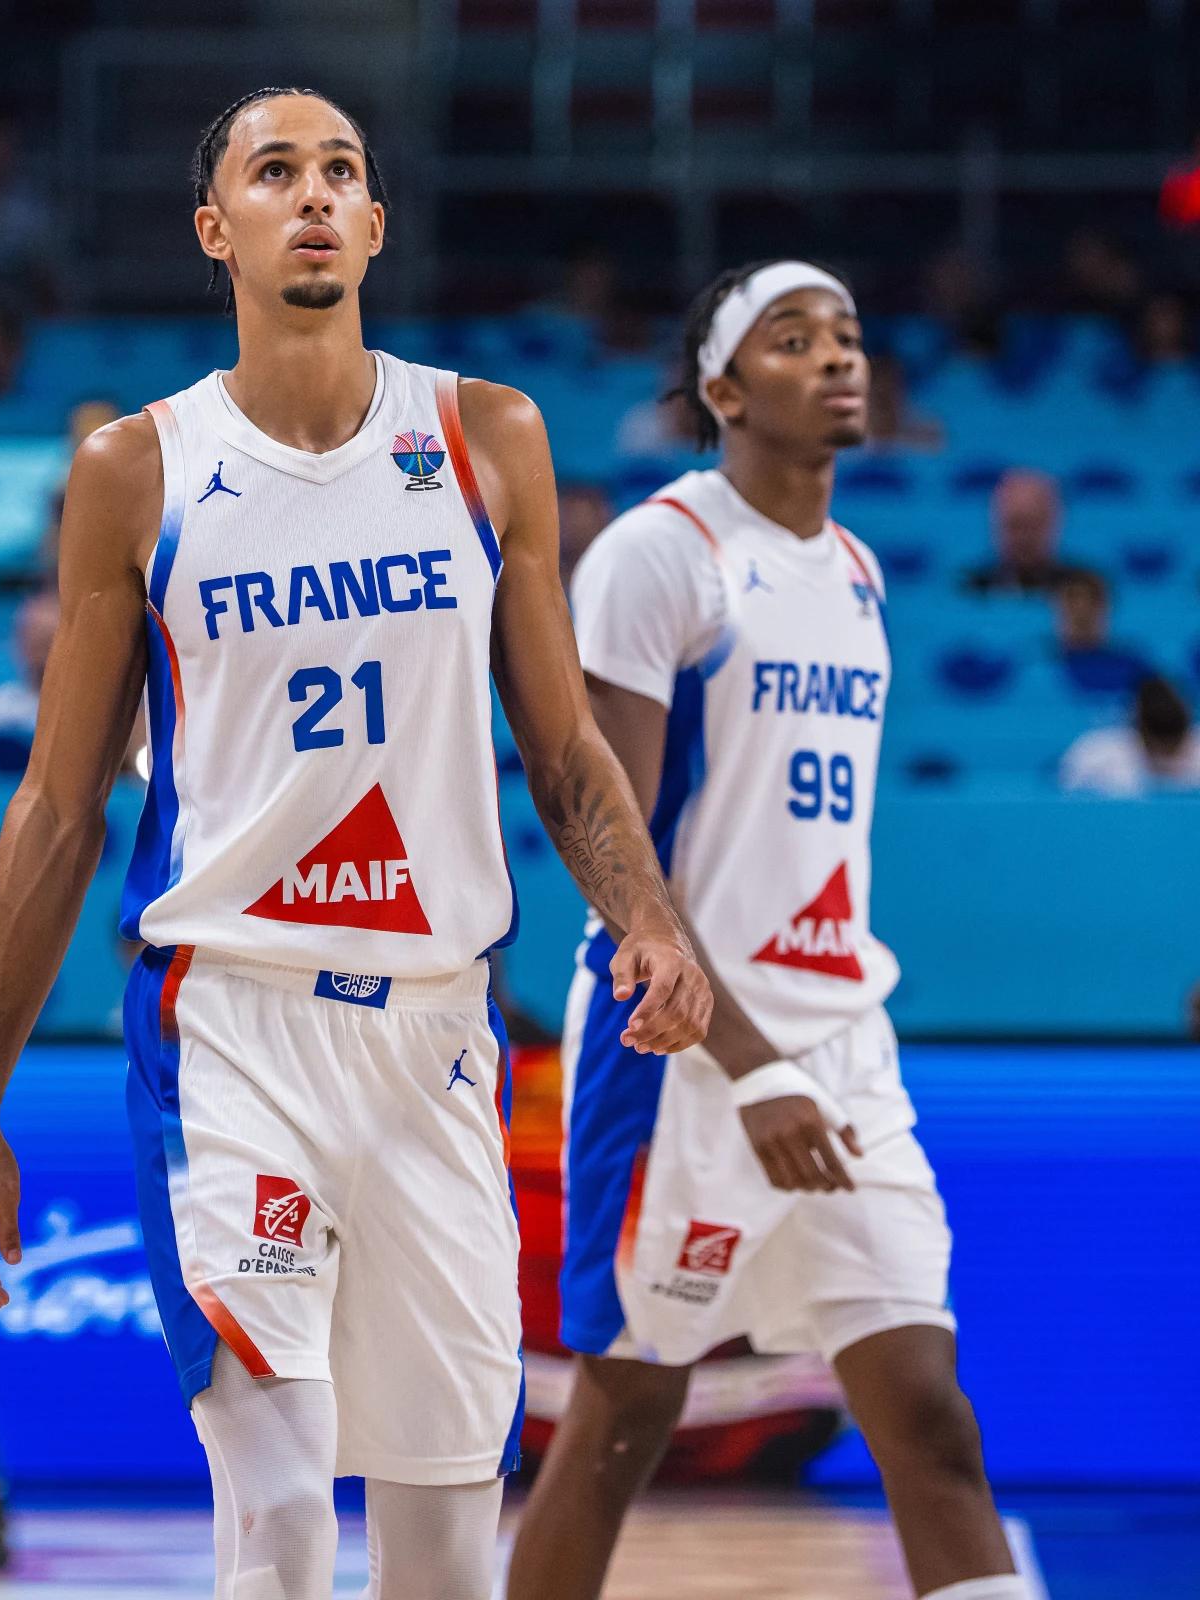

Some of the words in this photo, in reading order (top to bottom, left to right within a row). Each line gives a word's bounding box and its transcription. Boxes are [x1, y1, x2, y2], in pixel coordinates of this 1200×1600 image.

[198, 549, 458, 641] FRANCE
[288, 661, 387, 753] 21
[751, 661, 883, 721] FRANCE
[787, 749, 855, 824] 99
[282, 858, 416, 906] MAIF
[258, 1242, 296, 1267] CAISSE
